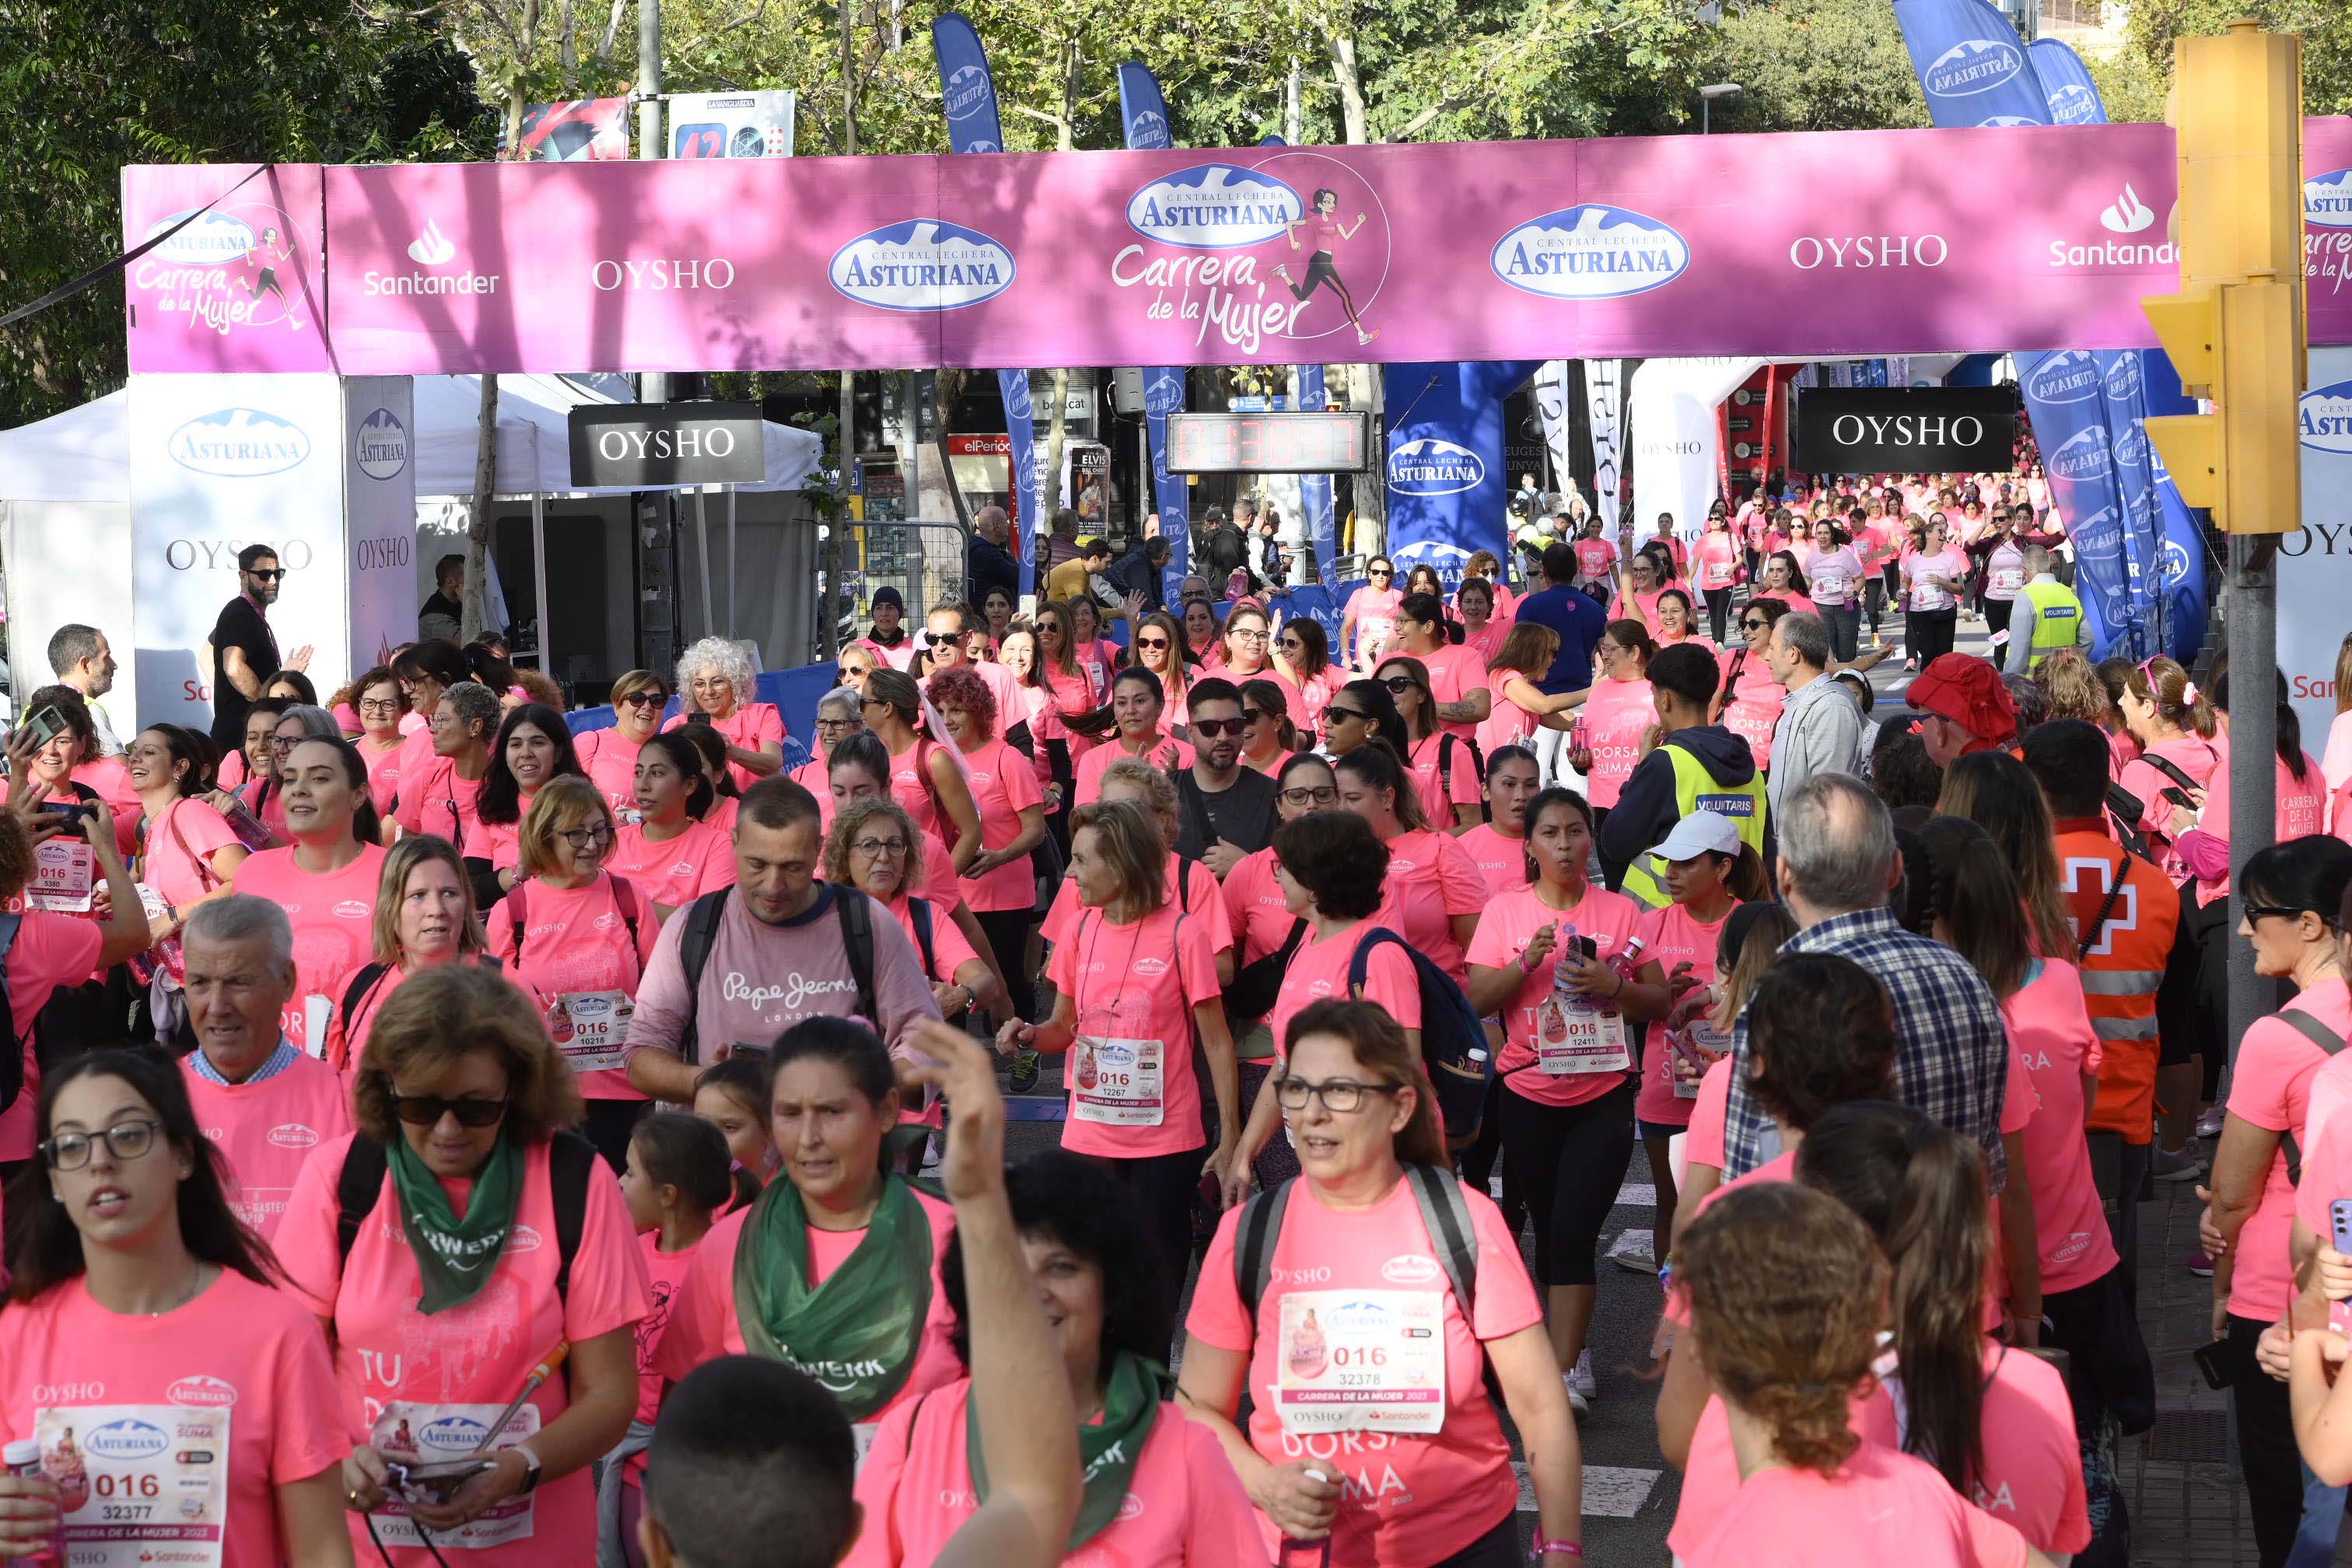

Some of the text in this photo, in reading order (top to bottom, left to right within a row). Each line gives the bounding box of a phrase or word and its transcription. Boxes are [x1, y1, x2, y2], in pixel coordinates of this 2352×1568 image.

[1167, 191, 1285, 202] CENTRAL LECHERA
[1140, 197, 1289, 227] ASTURIANA
[1537, 236, 1668, 247] CENTRAL LECHERA
[872, 250, 996, 260] CENTRAL LECHERA
[1507, 241, 1675, 275] ASTURIANA
[1790, 234, 1948, 268] OYSHO
[2049, 240, 2179, 267] Santand
[843, 250, 1002, 287] ASTURIANA
[1111, 244, 1257, 287] Carrera
[135, 261, 229, 290] Carrera
[592, 258, 734, 291] OYSHO
[364, 271, 499, 296] Santander
[158, 286, 262, 334] de la Mujer
[1147, 282, 1313, 355] de la Mujer
[1043, 398, 1085, 411] b.cat
[1832, 415, 1983, 446] OYSHO
[180, 433, 300, 460] ASTURIANA
[360, 435, 404, 462] ASTURIANA
[599, 427, 735, 460] OYSHO
[1082, 455, 1107, 464] ELVIS
[1390, 461, 1478, 483] ASTURIANA
[166, 538, 313, 570] OYSO
[358, 536, 409, 571] OYSHO
[2044, 607, 2074, 617] VOLUNTARIS
[1731, 717, 1771, 731] DORSA
[1595, 732, 1610, 743] TU
[1745, 735, 1764, 745] MA
[1594, 747, 1640, 759] DORSA
[1597, 762, 1632, 775] SUMA
[429, 799, 453, 807] OYSH
[611, 793, 629, 807] TU
[1697, 800, 1752, 813] VOLUNTARIS
[2281, 795, 2319, 810] CARRERA
[2290, 810, 2314, 821] DE LA
[2288, 821, 2315, 835] MUJER
[40, 867, 66, 878] 016
[1259, 896, 1287, 907] OYSH
[529, 922, 566, 936] OYSHO
[1661, 946, 1695, 956] OYSHO
[1134, 963, 1166, 971] ASTURIANA
[723, 971, 858, 1010] Pepe Jeans
[575, 1003, 608, 1012] ASTURIANA
[765, 1011, 824, 1024] LONDON
[576, 1022, 608, 1034] 016
[1570, 1024, 1597, 1035] 016
[1101, 1052, 1132, 1062] ASTURIANA
[1101, 1072, 1130, 1085] 016
[1103, 1088, 1126, 1097] 12267
[1083, 1107, 1105, 1117] OYSHO
[1270, 1266, 1332, 1285] OYSHO
[1334, 1347, 1388, 1366] 016
[357, 1348, 401, 1387] TU
[1339, 1374, 1381, 1386] 32378
[32, 1381, 106, 1403] OYSHO
[172, 1387, 233, 1402] ASTURIANA
[1297, 1391, 1428, 1402] CARRERA DE LA MUJER 2023
[1293, 1410, 1431, 1423] OYSHO Santander
[502, 1423, 527, 1433] UMA
[93, 1435, 163, 1450] ASTURIANA
[426, 1428, 485, 1444] ASTURIAN
[1281, 1426, 1399, 1459] DORS
[96, 1473, 160, 1497] 016
[1340, 1463, 1406, 1501] MA
[940, 1489, 977, 1509] OYS
[102, 1505, 152, 1521] 32377
[107, 1528, 124, 1538] DE
[125, 1528, 140, 1538] LA
[142, 1528, 180, 1538] MUJER
[383, 1523, 433, 1537] OYSHO
[70, 1550, 210, 1566] SHO Santander
